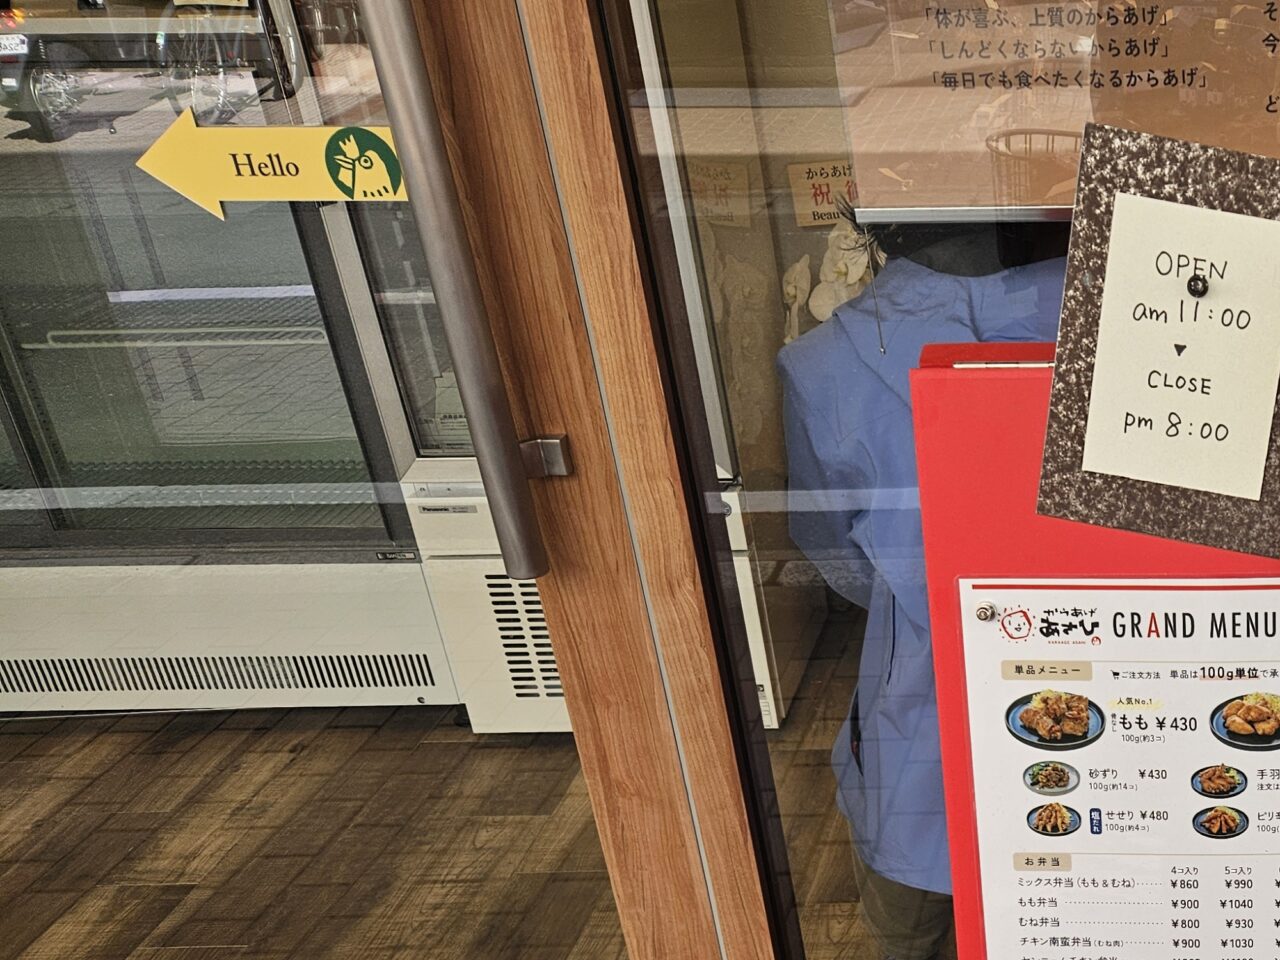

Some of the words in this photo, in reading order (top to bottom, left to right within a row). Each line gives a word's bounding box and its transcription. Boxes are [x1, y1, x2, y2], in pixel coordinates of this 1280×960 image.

[933, 69, 1208, 91] 「毎日でも食べたくなるからあげ」
[228, 153, 300, 177] Hello
[1155, 251, 1227, 279] OPEN
[1132, 302, 1168, 324] am
[1179, 299, 1251, 330] 11:00
[1147, 370, 1211, 395] CLOSE
[1124, 412, 1153, 434] pm
[1165, 411, 1229, 441] 8:00
[1043, 606, 1097, 617] からあげ
[1039, 616, 1099, 637] あさひ
[1112, 611, 1195, 639] GRAND
[1209, 611, 1278, 638] MENU
[1014, 664, 1081, 676] 単品メニュー
[1121, 670, 1161, 680] ご注文方法
[1118, 714, 1149, 731] もも
[1088, 768, 1118, 779] 砂ずり
[1138, 769, 1168, 780] ¥430
[1257, 768, 1280, 780] 手羽
[1105, 811, 1134, 821] せせり
[1139, 810, 1169, 822] ¥480
[1024, 857, 1060, 867] お弁当
[1171, 866, 1199, 876] 4コ入り
[1224, 866, 1253, 875] 5コ入り
[1170, 879, 1199, 890] ¥860
[1224, 879, 1253, 889] ¥990
[1018, 897, 1058, 908] もも弁当
[1171, 899, 1200, 910] ¥900
[1219, 899, 1254, 909] ¥1040
[1018, 916, 1060, 928] むね弁当
[1171, 918, 1200, 929] ¥800
[1225, 918, 1254, 929] ¥930
[1172, 938, 1201, 949] ¥900
[1220, 938, 1254, 948] ¥1030
